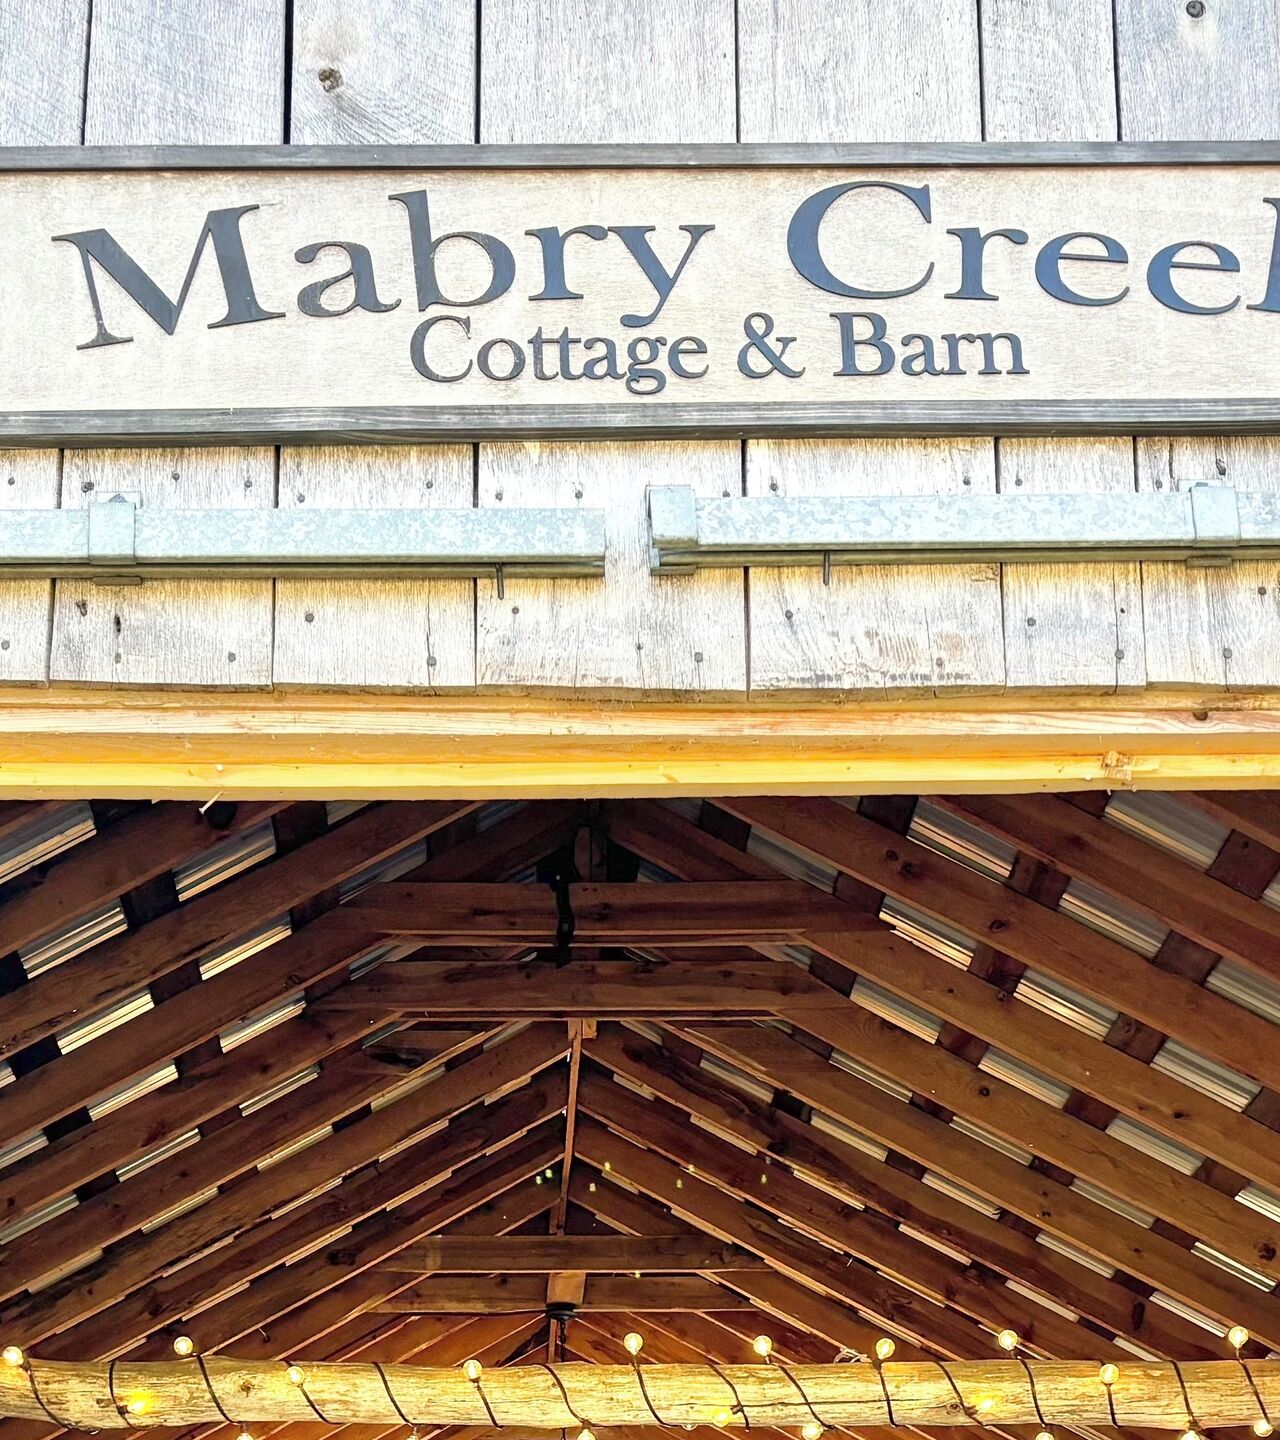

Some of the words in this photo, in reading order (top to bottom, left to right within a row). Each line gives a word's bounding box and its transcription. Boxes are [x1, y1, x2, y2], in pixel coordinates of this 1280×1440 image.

[51, 189, 716, 351] Mabry
[410, 315, 710, 395] Cottage
[737, 311, 806, 379] &
[832, 312, 1030, 377] Barn
